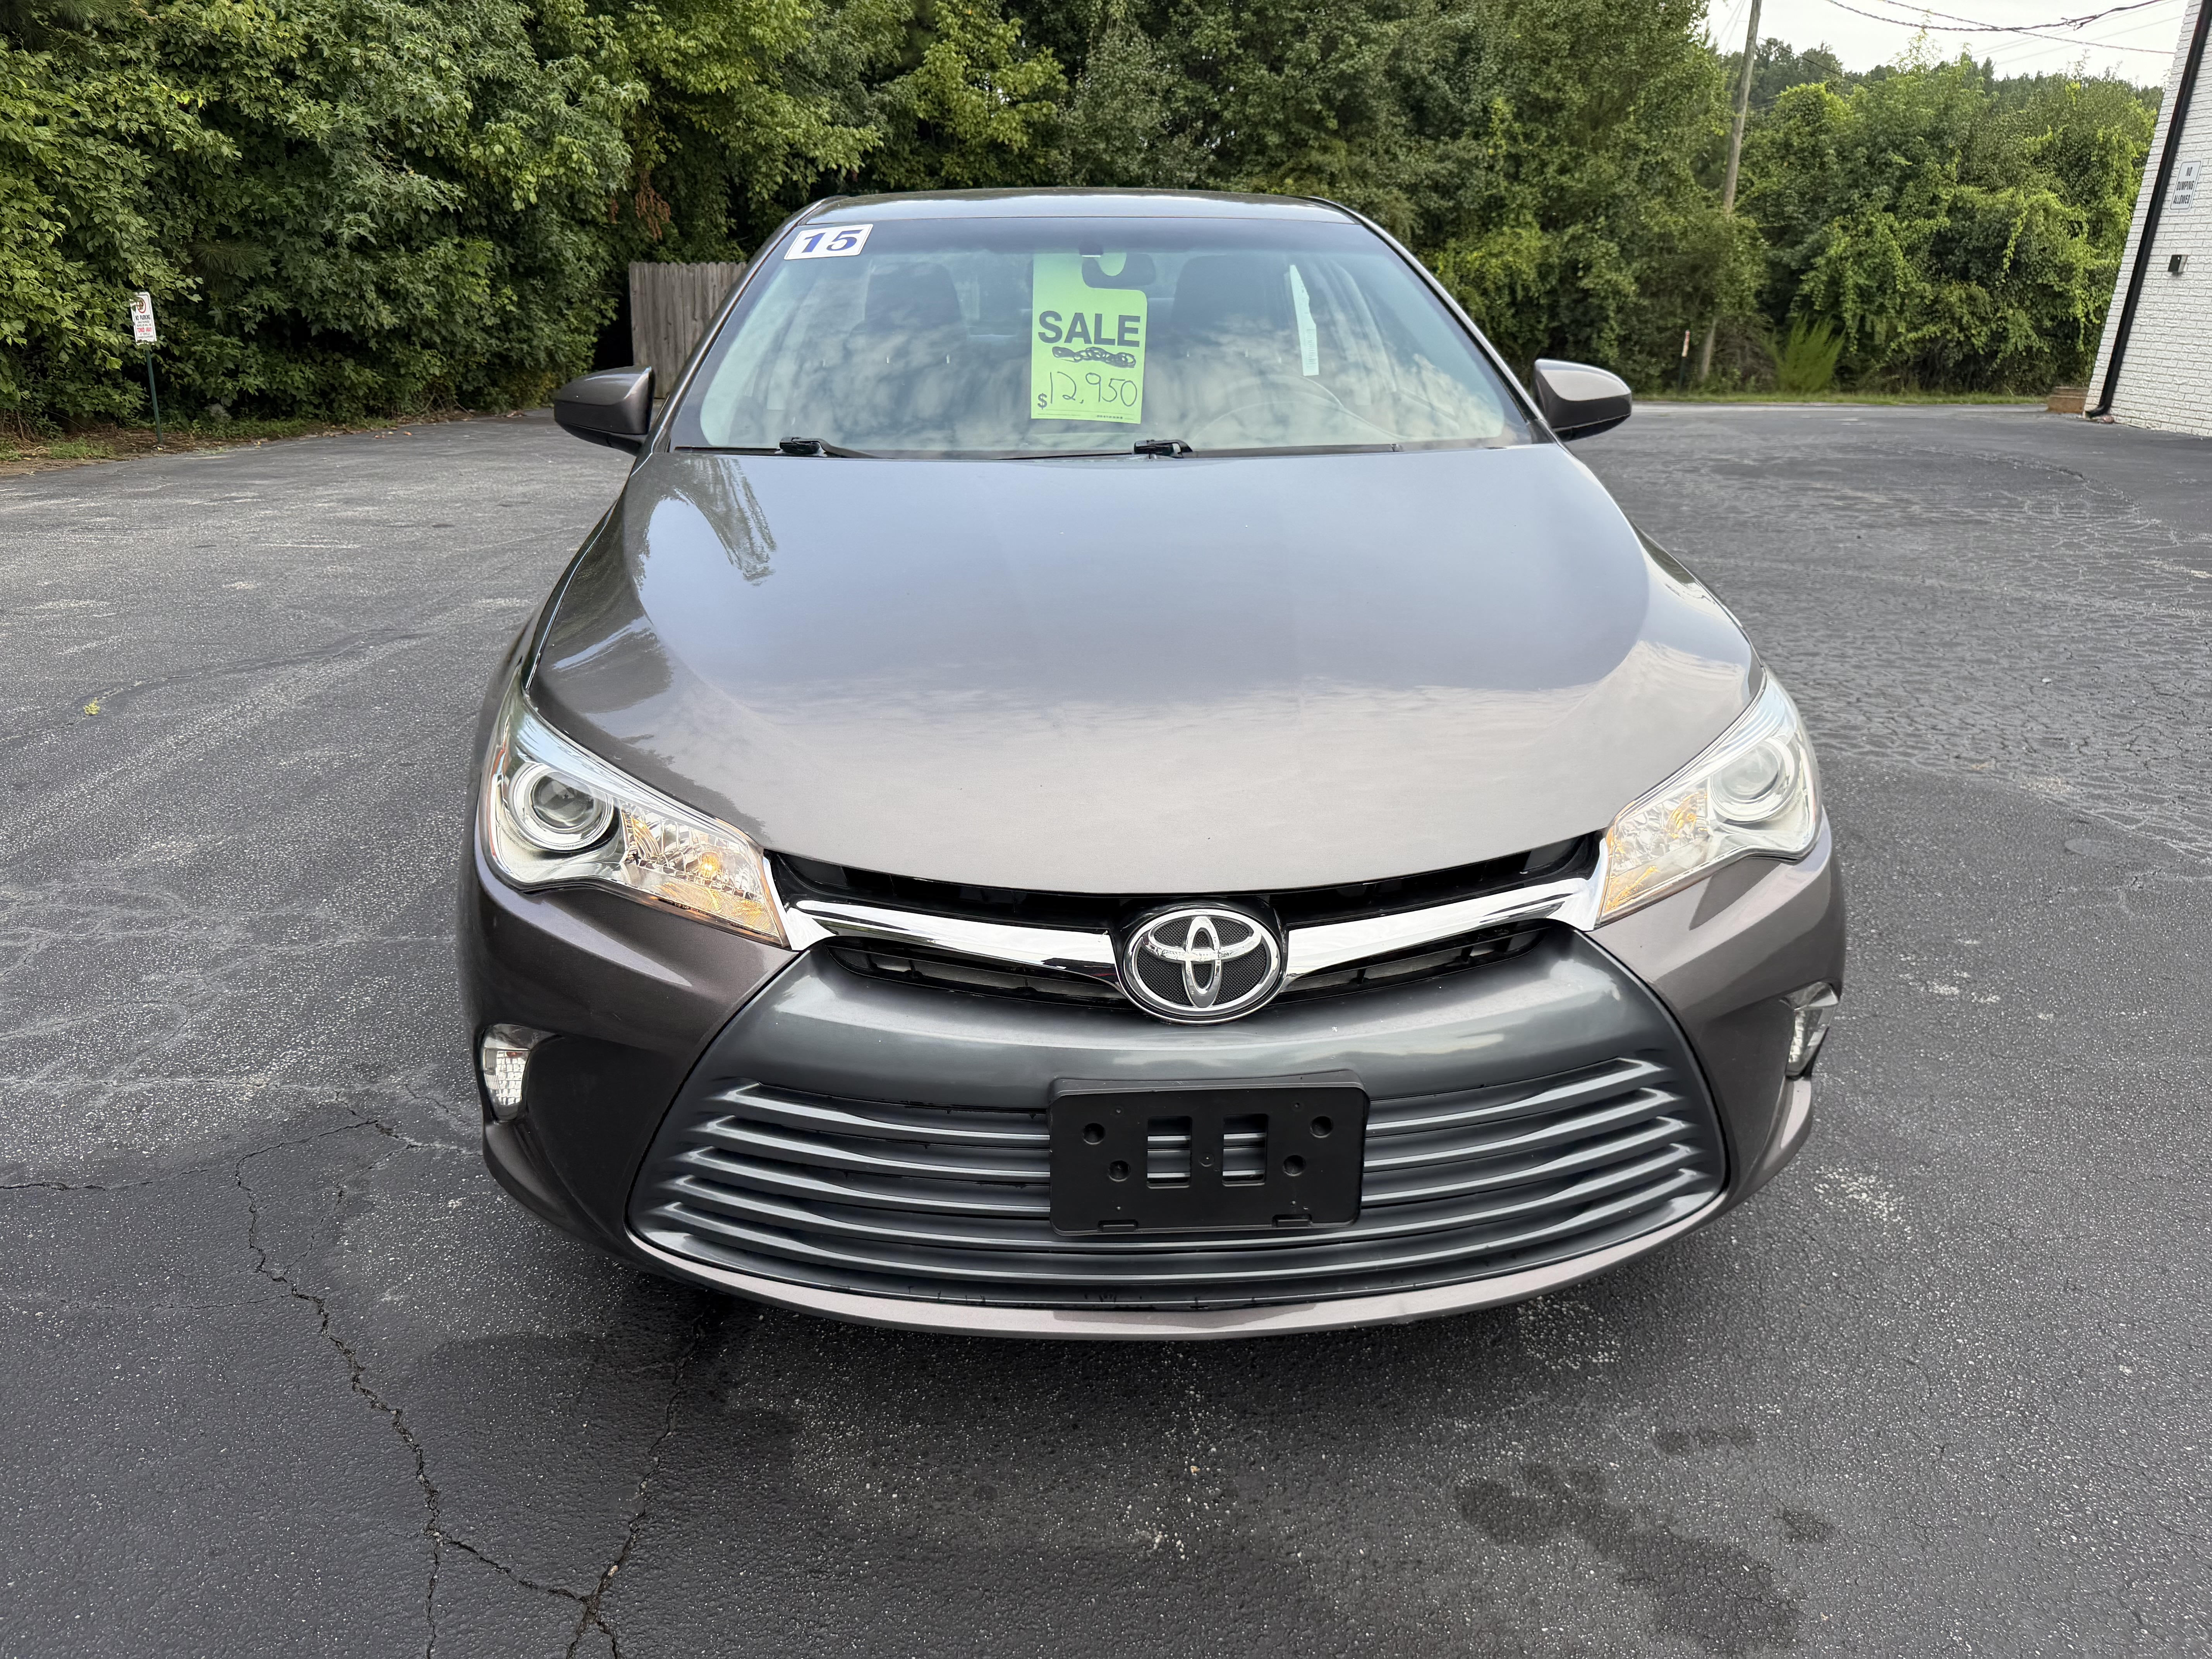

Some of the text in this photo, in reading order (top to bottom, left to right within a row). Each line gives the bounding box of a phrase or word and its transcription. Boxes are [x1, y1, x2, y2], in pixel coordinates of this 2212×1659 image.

[2185, 167, 2193, 176] NO
[2176, 181, 2194, 191] DUMPING
[2173, 195, 2190, 204] ALLOWED
[801, 228, 865, 253] 15
[1038, 310, 1141, 347] SALE
